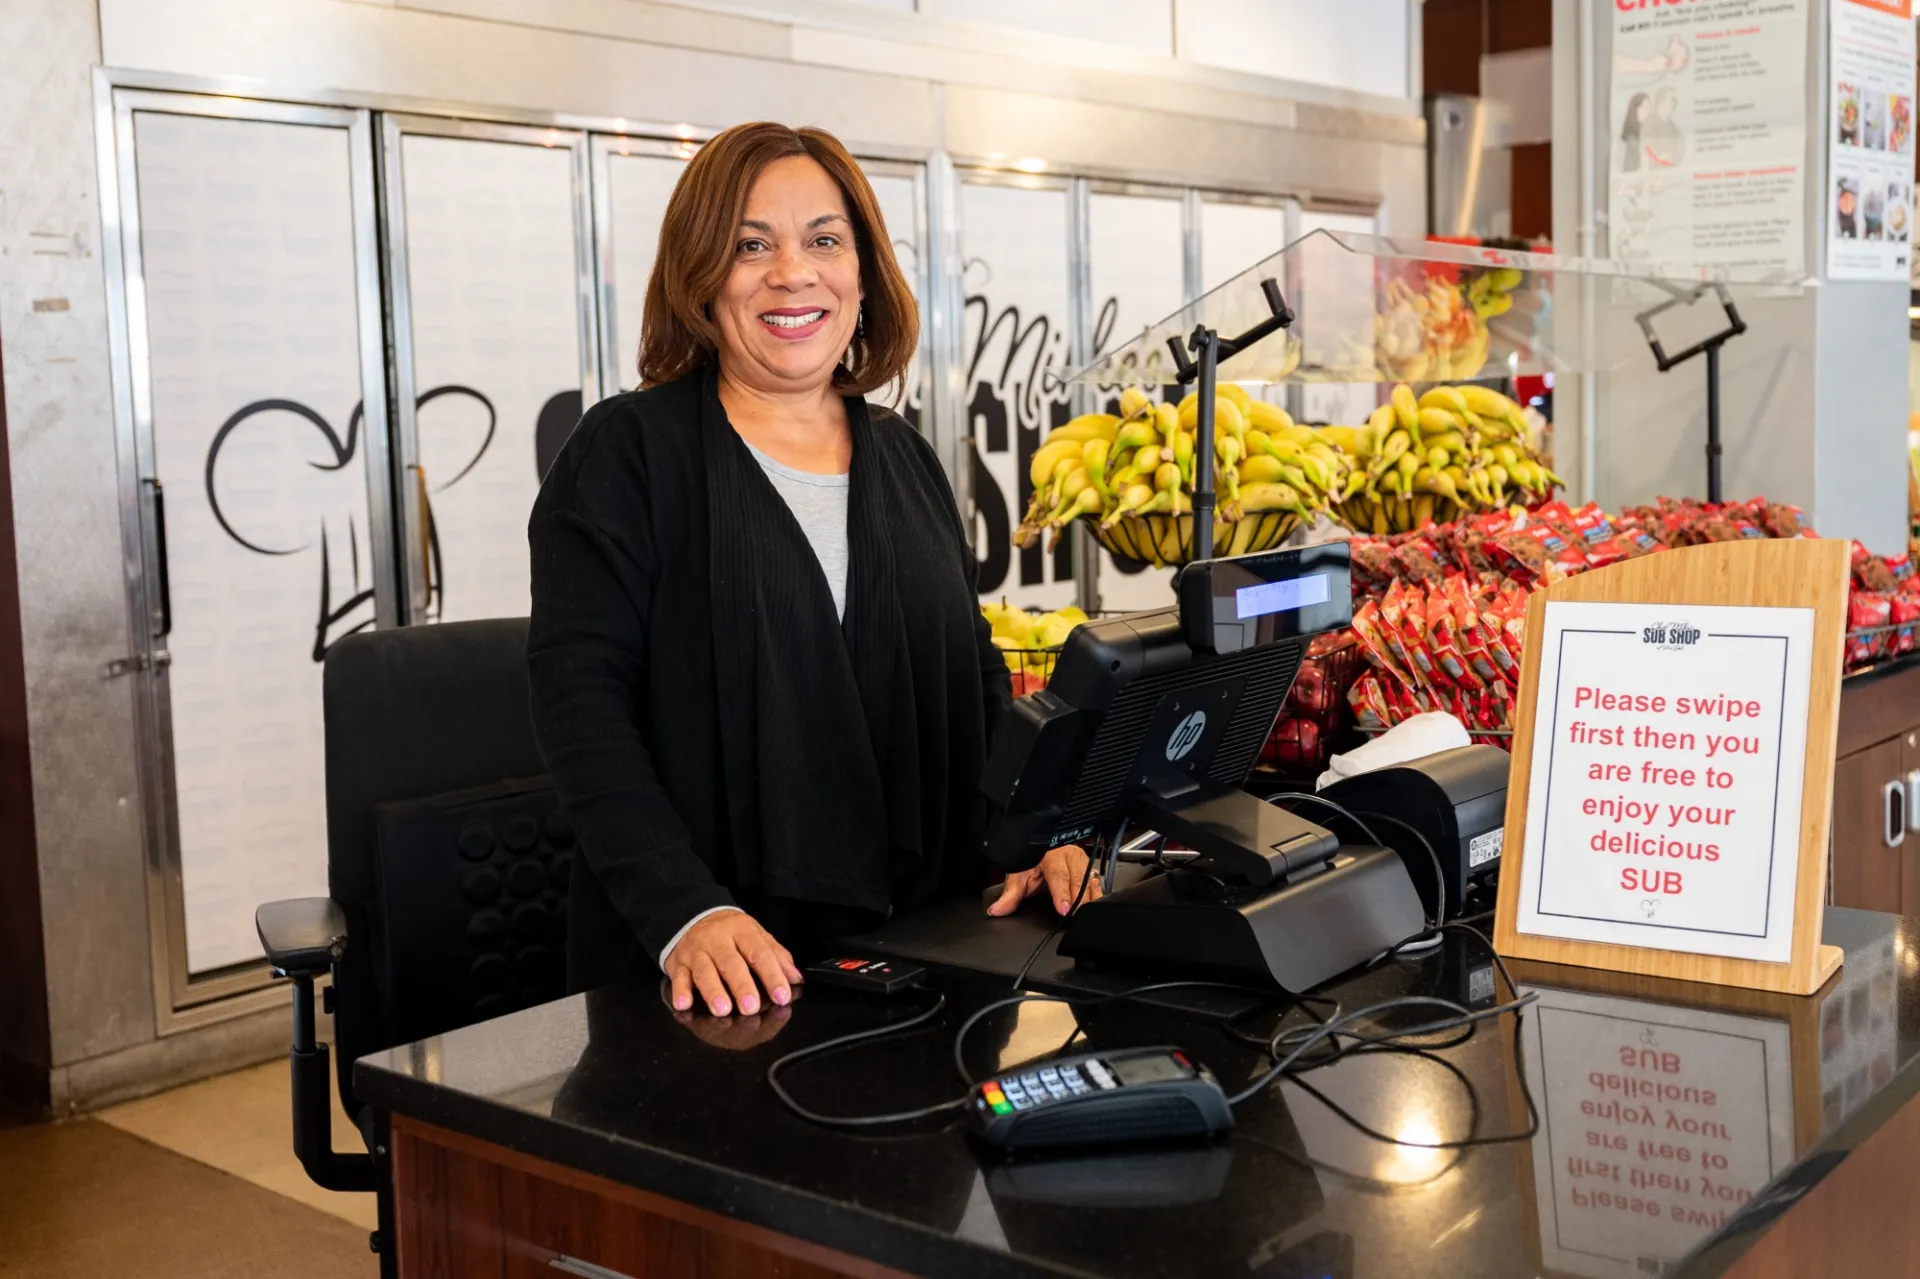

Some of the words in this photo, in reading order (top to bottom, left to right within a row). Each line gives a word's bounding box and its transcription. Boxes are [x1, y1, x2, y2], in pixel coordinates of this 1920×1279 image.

[1643, 627, 1666, 644] SUB
[1669, 628, 1701, 645] SHOP
[1574, 686, 1666, 713] Please
[1675, 693, 1761, 722] swipe
[1167, 711, 1206, 761] hp
[1569, 721, 1625, 746] first
[1633, 725, 1696, 750] then
[1705, 734, 1760, 758] you
[1587, 762, 1632, 782] are
[1641, 761, 1697, 787] free
[1705, 766, 1734, 789] to
[1581, 795, 1660, 824] enjoy
[1667, 803, 1736, 827] your
[1589, 830, 1720, 862] delicious
[1619, 867, 1684, 895] SUB
